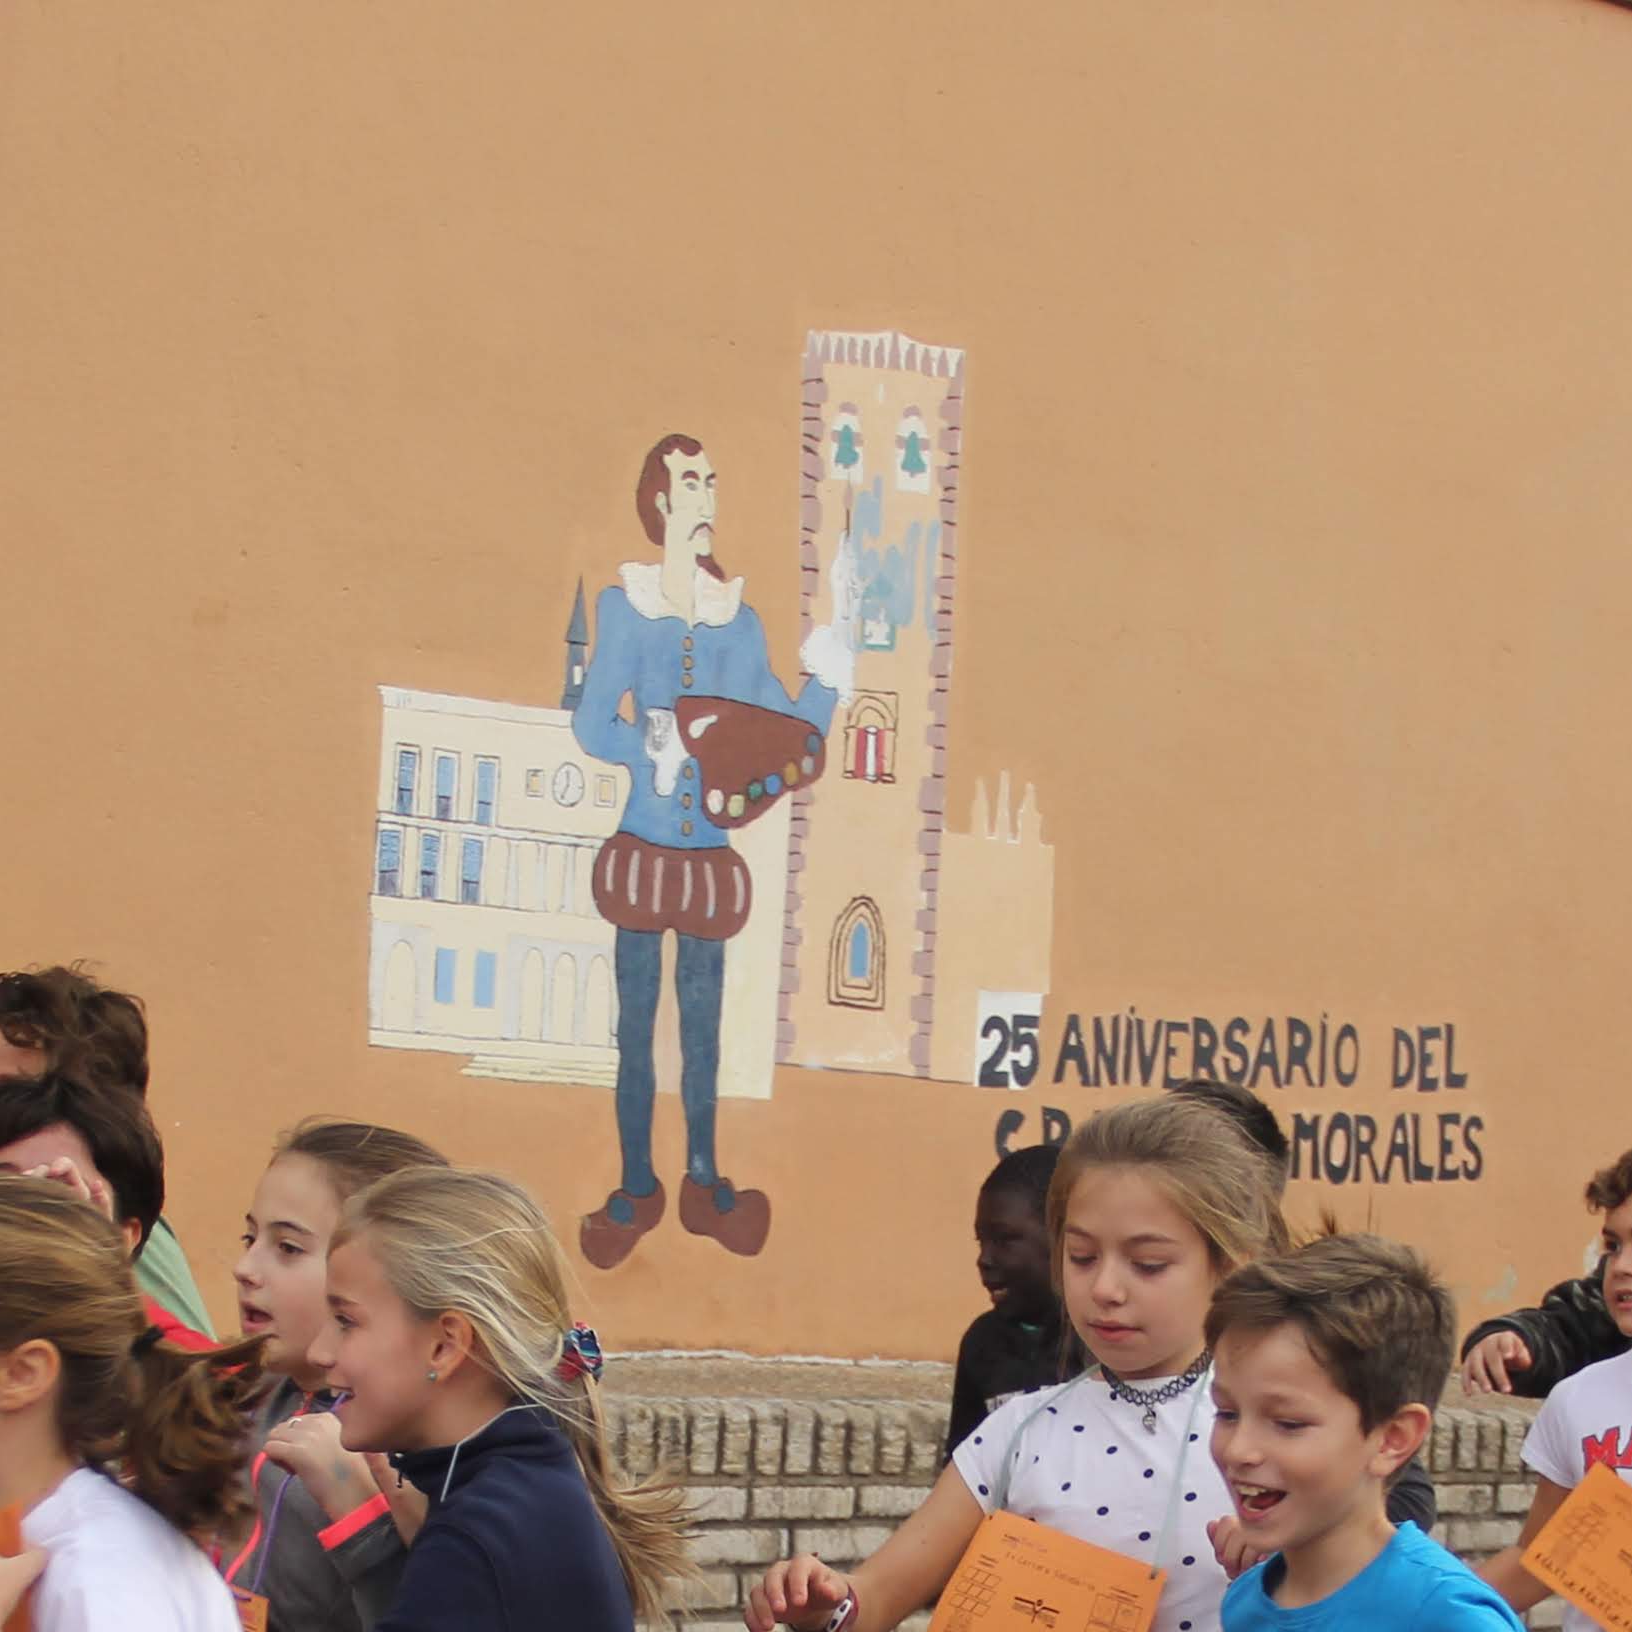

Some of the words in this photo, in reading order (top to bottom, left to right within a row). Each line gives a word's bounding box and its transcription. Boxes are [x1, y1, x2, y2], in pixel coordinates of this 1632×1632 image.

[979, 1014, 1039, 1089] 25
[1391, 1023, 1469, 1092] DEL
[1288, 1111, 1484, 1184] MORALES
